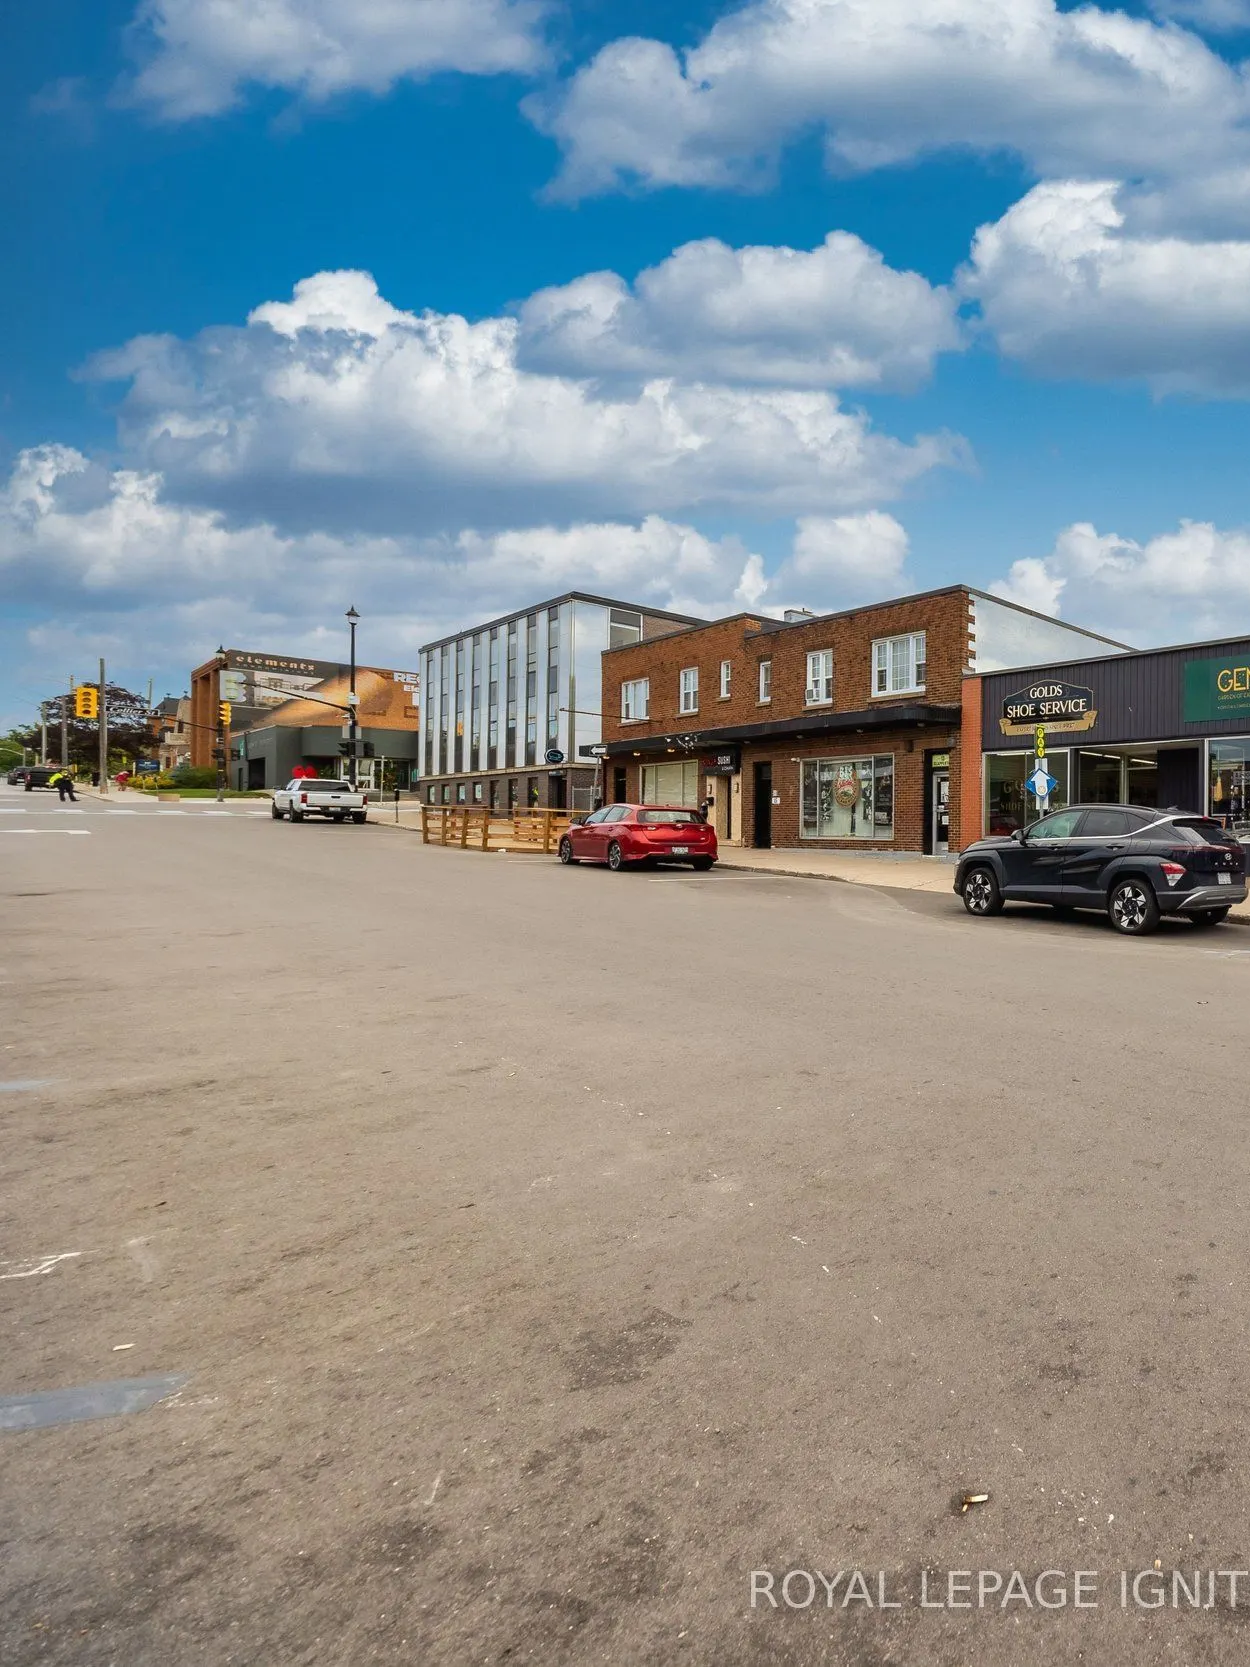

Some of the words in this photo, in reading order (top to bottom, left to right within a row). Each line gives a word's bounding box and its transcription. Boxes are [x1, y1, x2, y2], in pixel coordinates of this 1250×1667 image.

[235, 655, 315, 671] elements
[1029, 684, 1063, 699] GOLDS
[109, 706, 143, 715] Collier
[1006, 703, 1036, 718] SHOE
[1039, 698, 1087, 715] SERVICE
